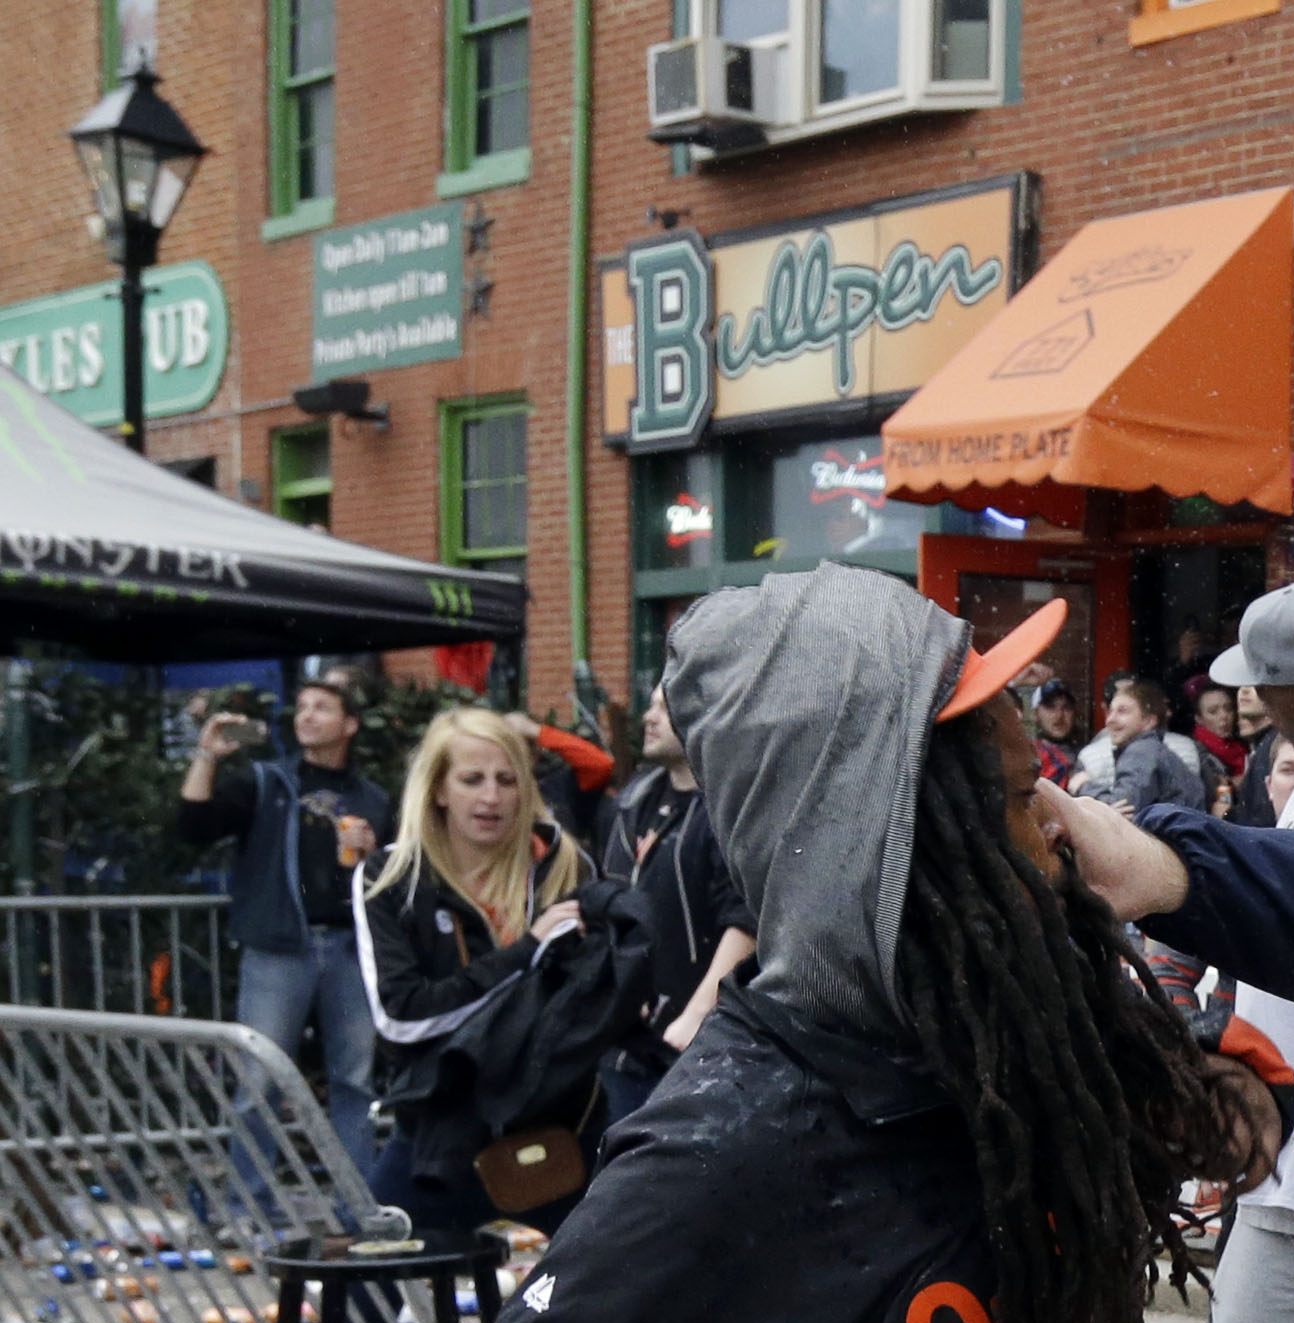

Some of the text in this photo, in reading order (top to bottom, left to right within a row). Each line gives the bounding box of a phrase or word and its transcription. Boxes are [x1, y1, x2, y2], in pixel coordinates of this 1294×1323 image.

[146, 298, 211, 374] UB
[606, 325, 634, 366] THE
[629, 229, 1001, 442] Bullpen
[888, 424, 1072, 467] FROM HOME PLATE
[4, 527, 249, 588] ONSTER
